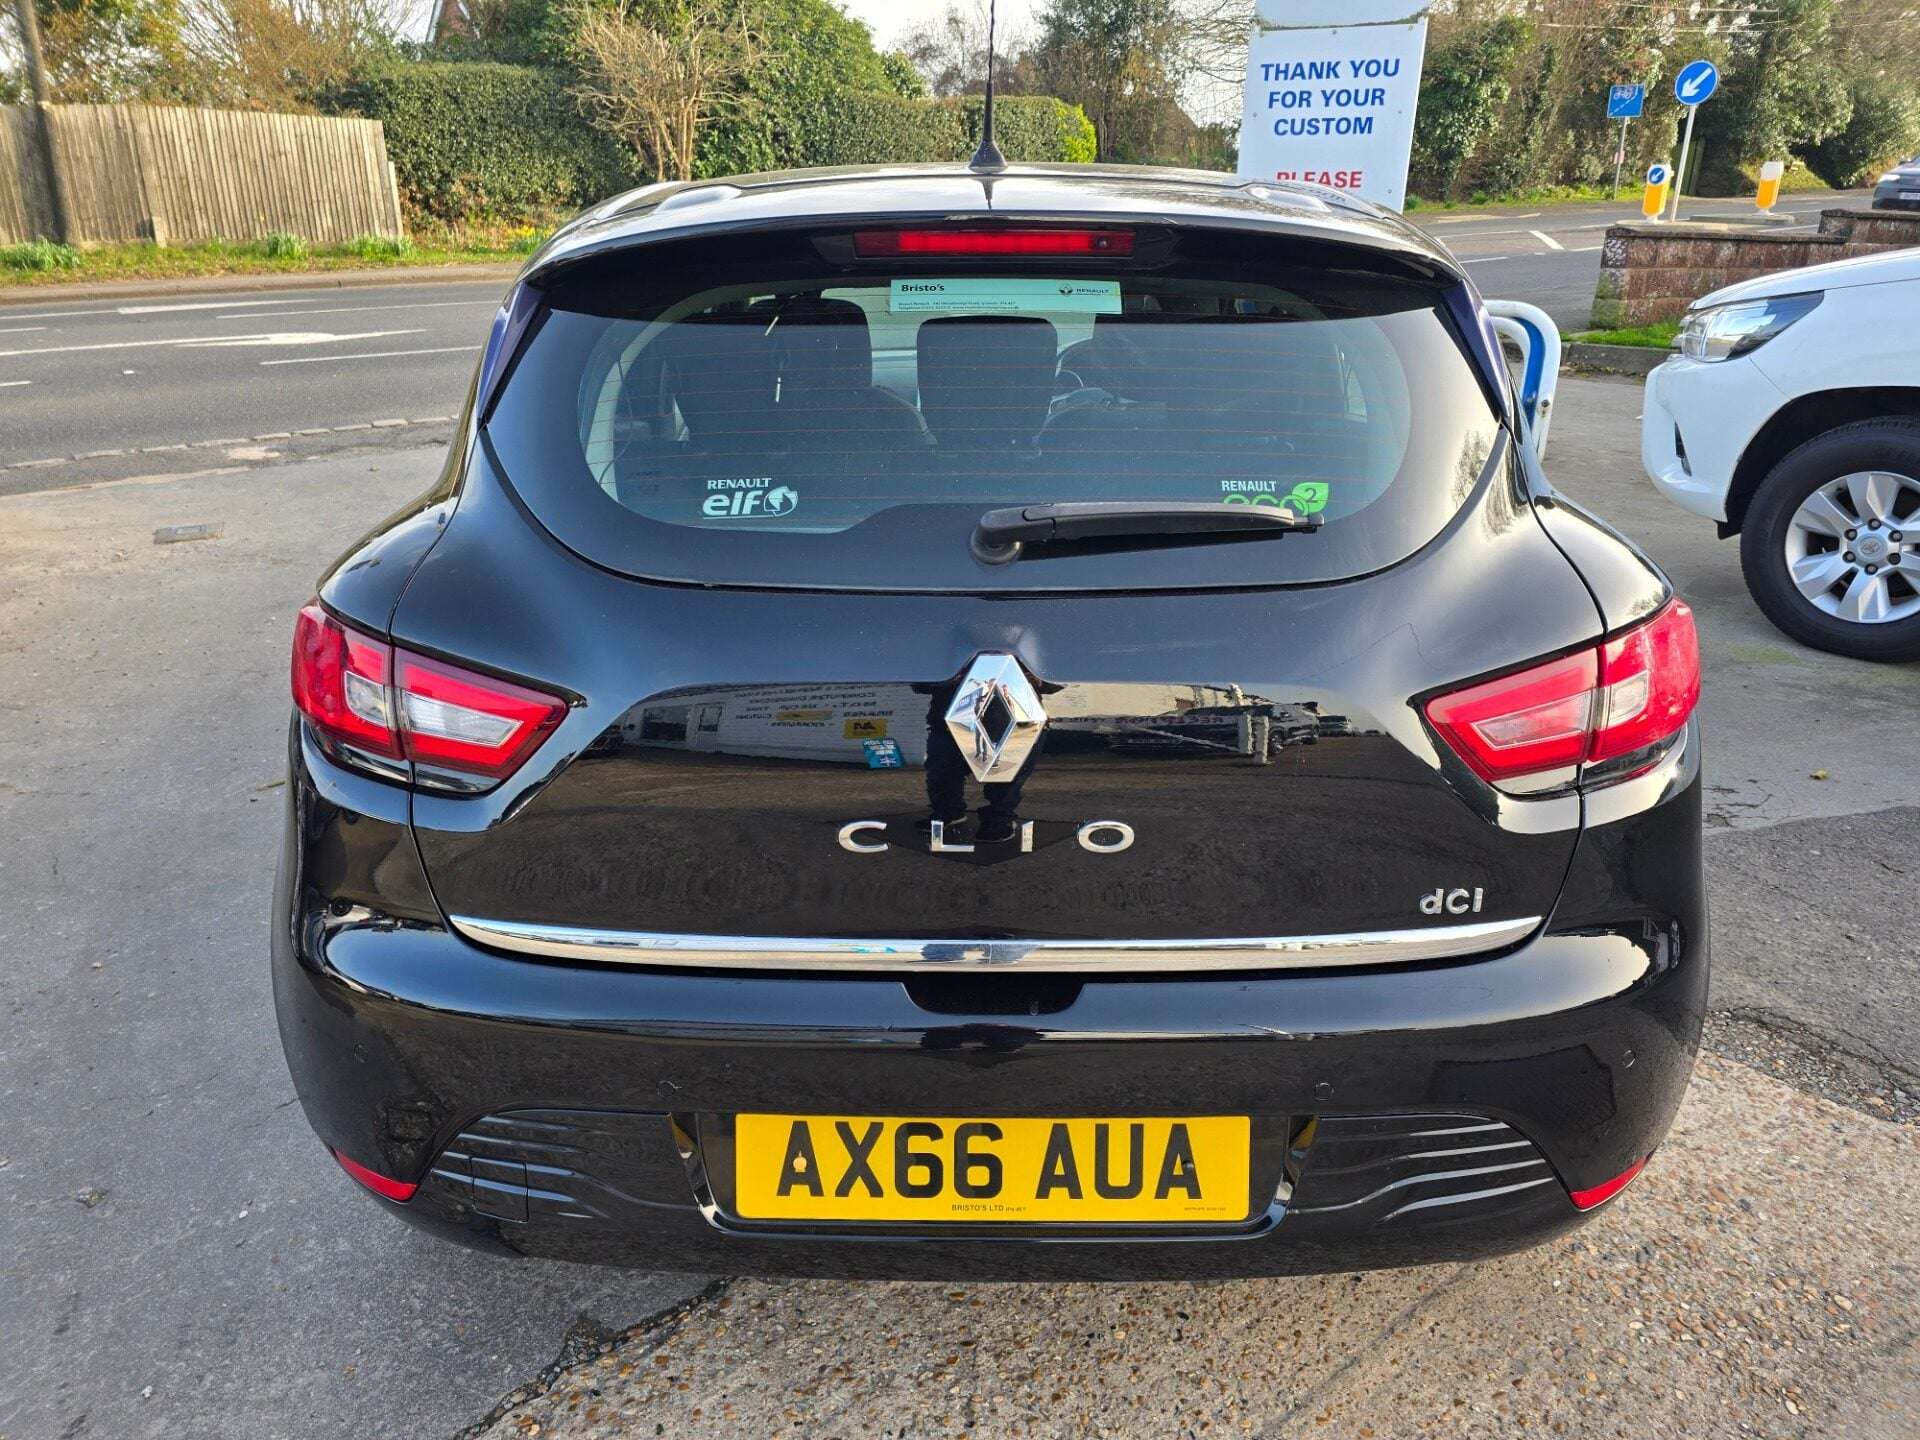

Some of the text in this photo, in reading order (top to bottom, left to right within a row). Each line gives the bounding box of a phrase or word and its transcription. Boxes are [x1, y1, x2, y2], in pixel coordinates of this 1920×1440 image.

[1260, 58, 1400, 81] THANK YOU
[1268, 88, 1385, 109] FOR YOUR
[1274, 116, 1373, 135] CUSTOM
[901, 284, 945, 292] Bristo's
[707, 478, 772, 490] RENAULT
[1221, 480, 1277, 492] RENAULT
[702, 490, 763, 516] elf
[838, 820, 1135, 853] CLIO
[776, 1120, 1203, 1200] AX66 AUA
[989, 1204, 1004, 1212] LTD
